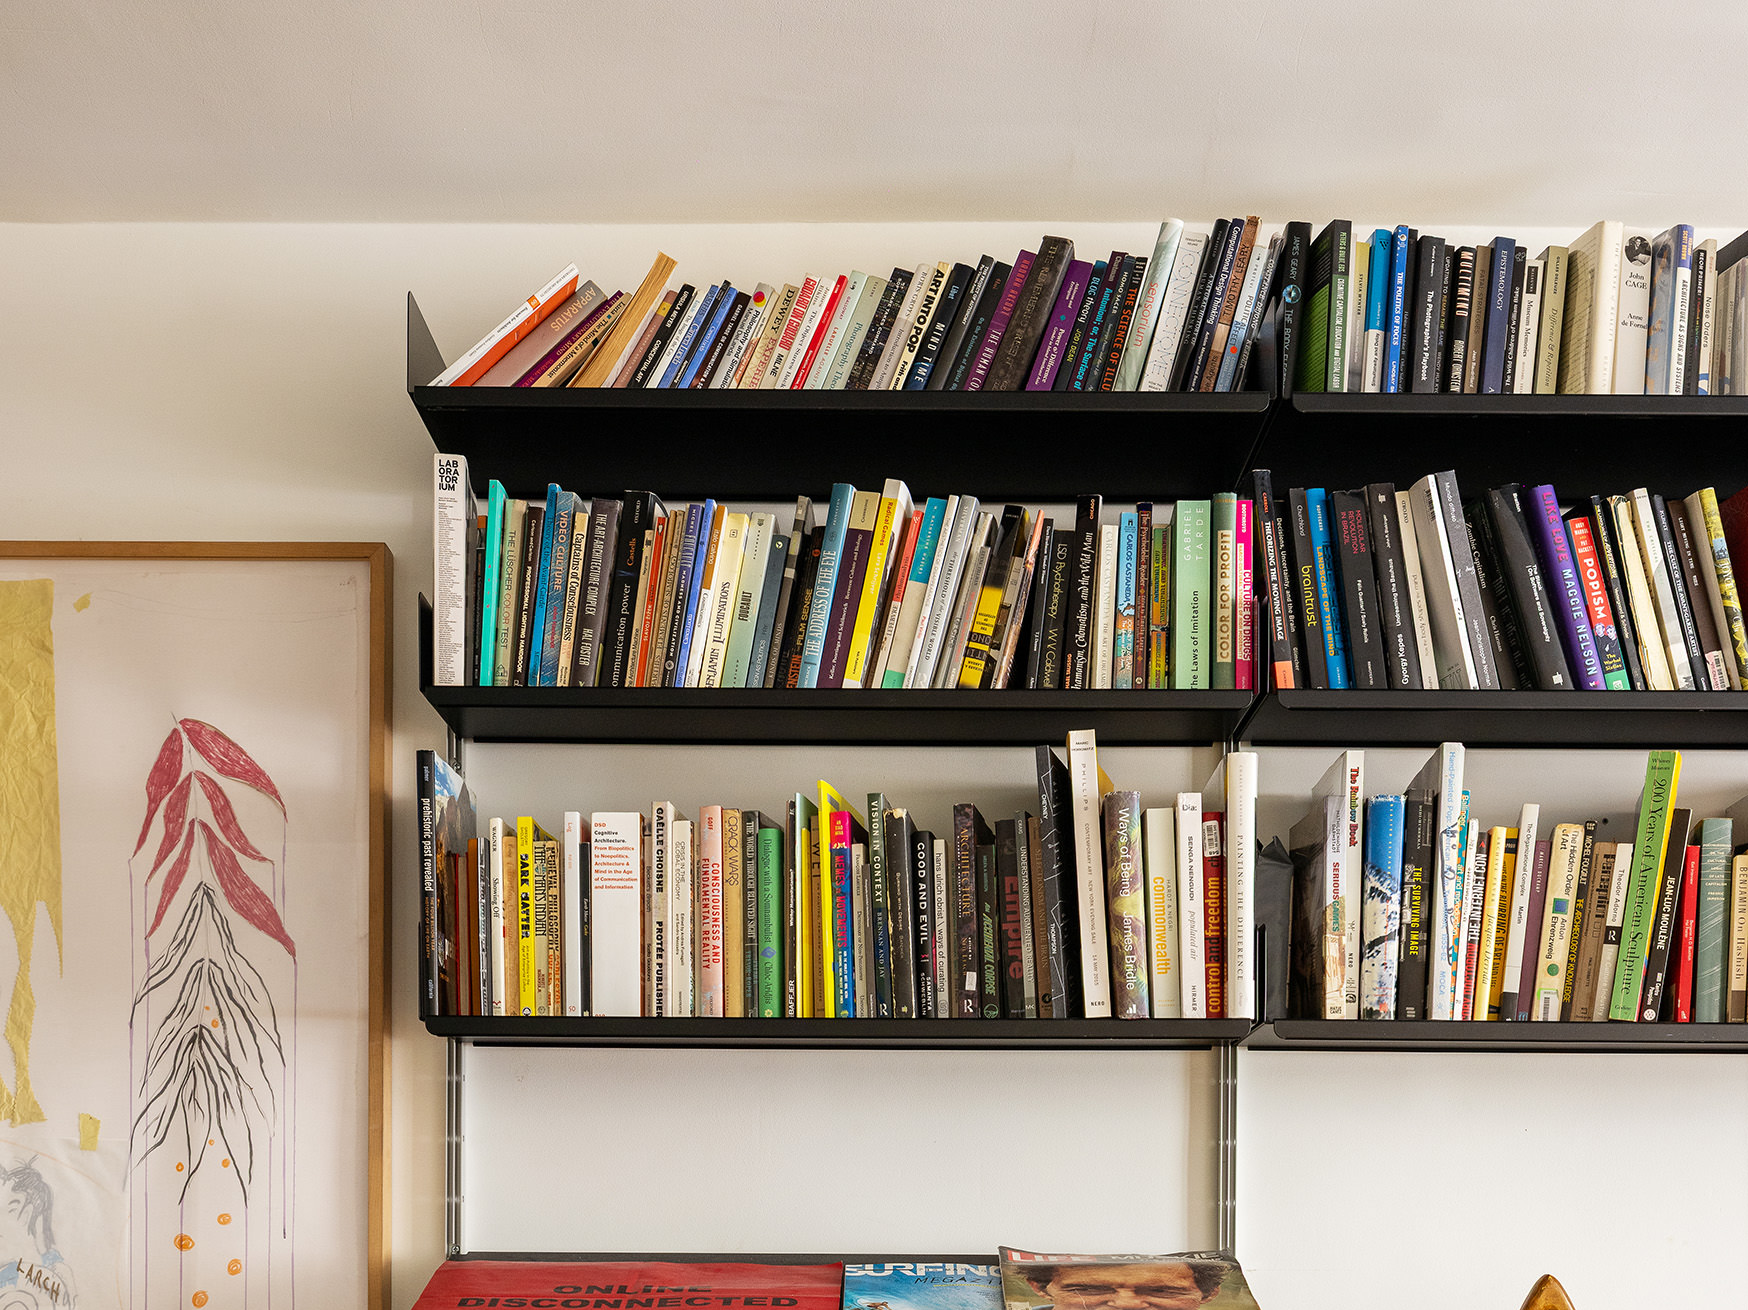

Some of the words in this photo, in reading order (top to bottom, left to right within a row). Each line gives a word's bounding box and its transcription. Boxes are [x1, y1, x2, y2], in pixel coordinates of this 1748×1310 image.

[1219, 225, 1241, 273] Computational
[927, 268, 946, 296] ART
[1086, 275, 1100, 296] BLOG
[1213, 272, 1228, 296] Design
[1221, 275, 1241, 319] TIMOTHY
[1234, 244, 1250, 272] LEARY
[1454, 250, 1474, 317] MULTIMIND
[1495, 250, 1507, 310] EPISTEMOLOGY
[1626, 280, 1647, 290] CAGE
[1629, 272, 1644, 280] John
[549, 286, 597, 332] APPARATUS
[768, 288, 795, 333] DEWEY
[915, 295, 936, 327] INTO
[1077, 295, 1095, 323] theory
[1205, 296, 1222, 325] Thinking
[1394, 286, 1402, 314] POLITICS
[1425, 290, 1434, 302] The
[1703, 296, 1712, 318] Noise
[1132, 280, 1160, 348] sensorium
[1393, 315, 1400, 324] OF
[1421, 303, 1433, 350] Photographer's
[903, 324, 923, 354] POP
[926, 321, 945, 352] MIND
[1391, 325, 1399, 345] FOCUS
[1700, 321, 1710, 348] Orders
[769, 352, 784, 377] MILNE
[914, 354, 933, 384] TIME
[1419, 352, 1429, 381] Playbook
[438, 458, 458, 468] LAB
[438, 468, 460, 476] ORA
[438, 476, 458, 484] TOR
[438, 483, 456, 492] IUM
[557, 509, 568, 543] VIDEO
[595, 512, 607, 525] THE
[1183, 507, 1192, 561] GABRIEL
[1195, 507, 1204, 560] TARDE
[1541, 490, 1559, 524] LIKE
[1550, 526, 1569, 562] LOVE
[507, 529, 516, 547] THE
[570, 532, 585, 571] Captains
[625, 536, 637, 566] Castells
[1055, 542, 1068, 560] LSD
[504, 549, 516, 591] LÜSCHER
[553, 545, 565, 591] CULTURE
[588, 525, 606, 585] ART-ARCHITECTURE
[822, 549, 837, 566] EYE
[1220, 532, 1230, 579] PROFIT
[1464, 521, 1477, 550] Zombie
[1471, 549, 1488, 589] Capitalism
[570, 571, 580, 581] of
[819, 566, 834, 584] THE
[1044, 560, 1067, 619] Psychotherapy
[1582, 557, 1607, 619] POPISM
[584, 585, 598, 615] COMPLEX
[800, 587, 814, 621] SENSE
[816, 585, 831, 598] OF
[1219, 584, 1230, 609] FOR
[1298, 564, 1321, 627] braintrust
[1316, 546, 1328, 598] LANDSCAPE
[1322, 600, 1329, 612] OF
[1326, 633, 1334, 656] MIND
[501, 592, 511, 625] COLOR
[562, 580, 579, 641] Consciousness
[712, 580, 734, 644] ILLUMINATIONS
[809, 598, 828, 638] ADDRESS
[1560, 567, 1584, 620] MAGGIE
[1575, 624, 1598, 675] NELSON
[499, 626, 508, 648] TEST
[581, 627, 593, 641] HAL
[609, 616, 627, 686] ommunication
[620, 583, 633, 614] power
[795, 622, 807, 646] FILM
[806, 638, 821, 657] THE
[1219, 614, 1230, 658] COLOR
[577, 641, 592, 666] FOSTER
[1650, 777, 1666, 803] 200
[420, 798, 432, 838] prehistoric
[656, 807, 664, 845] GAËLLE
[726, 815, 738, 852] CRACK
[870, 800, 879, 836] VISION
[1116, 807, 1129, 842] Ways
[1643, 803, 1663, 843] Years
[422, 840, 433, 856] past
[872, 839, 880, 850] IN
[1120, 845, 1130, 858] of
[1569, 830, 1579, 844] The
[1641, 845, 1656, 860] of
[726, 854, 738, 885] WARS
[916, 842, 925, 878] GOOD
[1412, 867, 1422, 881] THE
[1565, 844, 1577, 873] Hidden
[422, 858, 434, 891] revealed
[873, 855, 882, 902] CONTEXT
[1119, 862, 1132, 896] Being
[1331, 862, 1339, 900] SERIOUS
[1562, 873, 1573, 897] Order
[699, 857, 709, 926] FUNDAMENTAL
[710, 862, 720, 941] CONSCIOUSNESS
[918, 882, 926, 909] AND
[1409, 884, 1421, 927] SURVIVING
[1629, 860, 1654, 929] American
[875, 912, 883, 946] BRENNAN
[919, 914, 928, 944] EVIL
[1121, 911, 1134, 951] James
[1150, 876, 1172, 974] commonwealth
[1187, 910, 1198, 948] populated
[1331, 900, 1339, 931] GAMES
[1557, 917, 1567, 940] Anton
[701, 929, 710, 969] REALITY
[711, 944, 720, 963] AND
[1188, 948, 1198, 960] air
[1236, 917, 1244, 979] DIFFERENCE
[1408, 930, 1419, 955] IMAGE
[1124, 955, 1137, 990] Bridle
[1617, 929, 1643, 996] Sculpture
[16, 1258, 60, 1303] LARCH
[457, 1296, 800, 1309] DISCONNECTED
